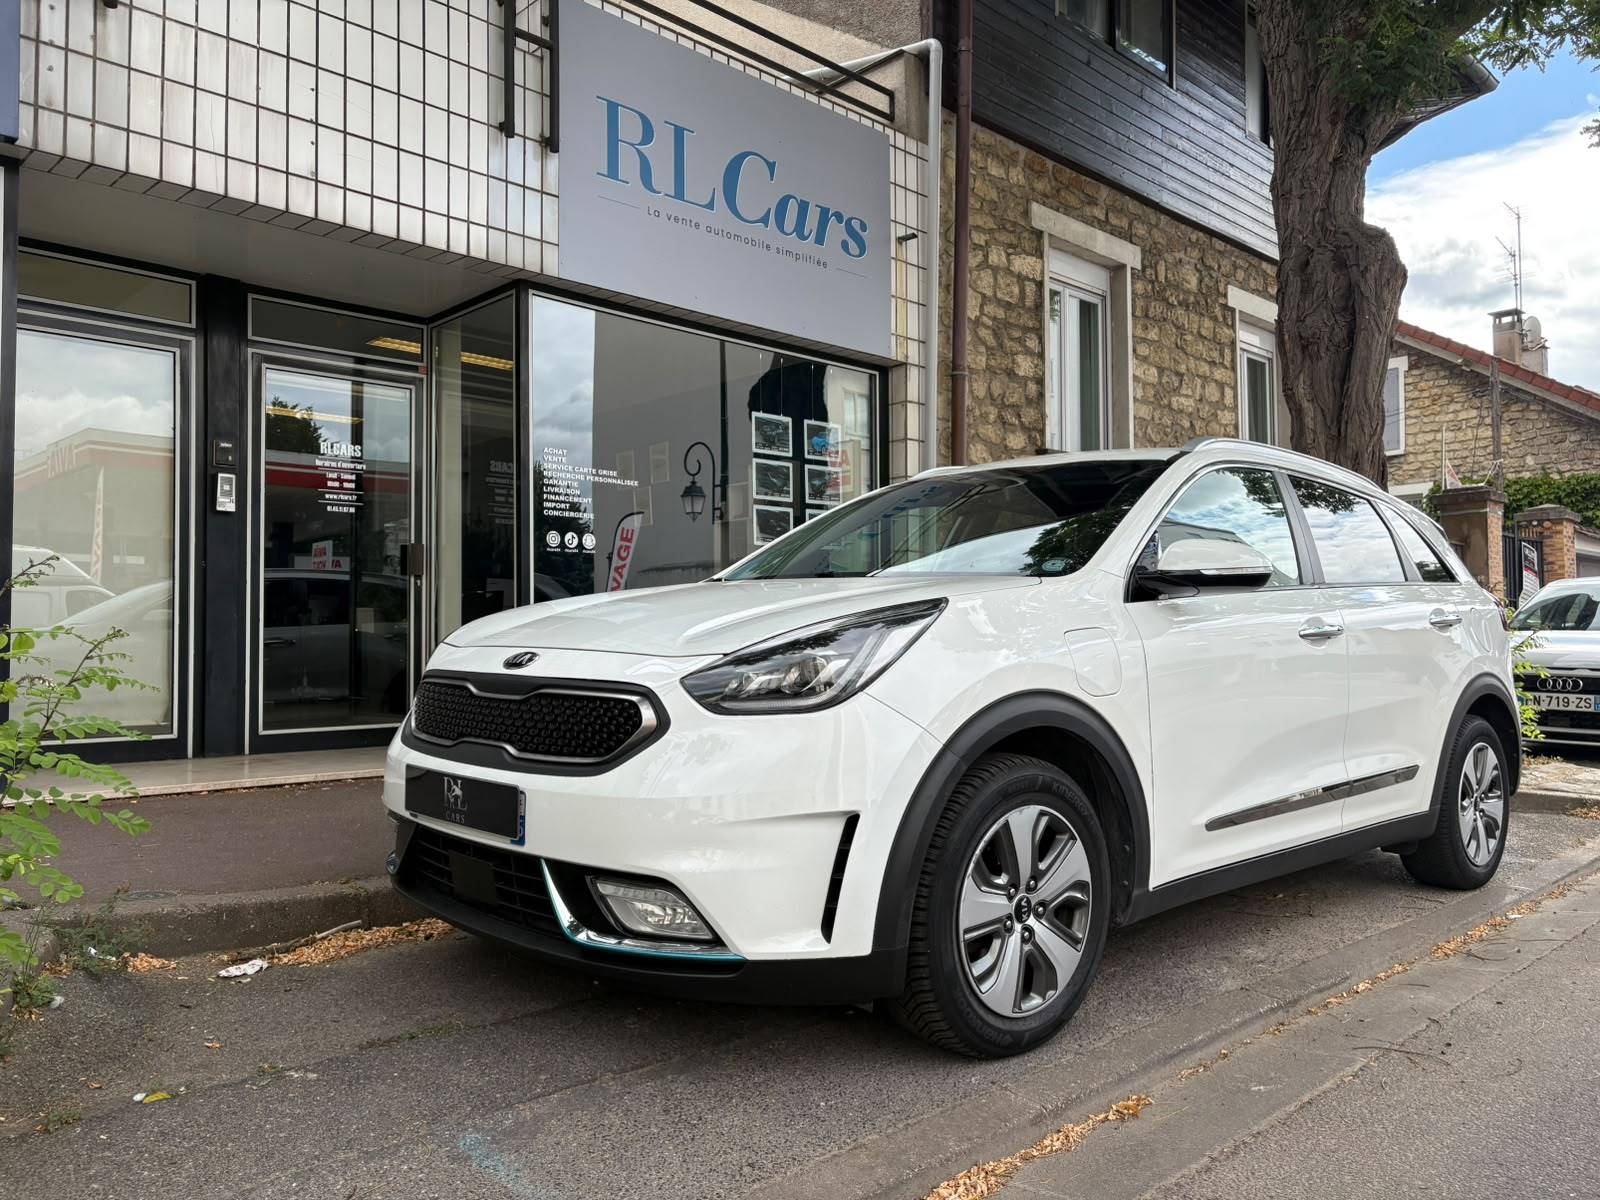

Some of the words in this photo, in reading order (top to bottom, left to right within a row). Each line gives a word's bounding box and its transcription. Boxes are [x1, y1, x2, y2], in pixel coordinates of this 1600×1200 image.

[647, 205, 661, 219] La
[666, 212, 701, 231] vente
[705, 222, 772, 252] automobile
[775, 245, 829, 270] simplifiée
[543, 447, 567, 456] ACHAT
[543, 454, 567, 463] VENTE
[543, 462, 573, 472] SERVICE
[574, 466, 597, 475] CARTE
[598, 469, 618, 477] GRISE
[543, 470, 585, 480] RECHERCHE
[543, 478, 579, 488] GARANTIE
[543, 486, 581, 496] LIVRAISON
[543, 494, 593, 504] FINANCEMENT
[543, 501, 571, 510] IMPORT
[543, 509, 595, 520] CONCIERGERIE
